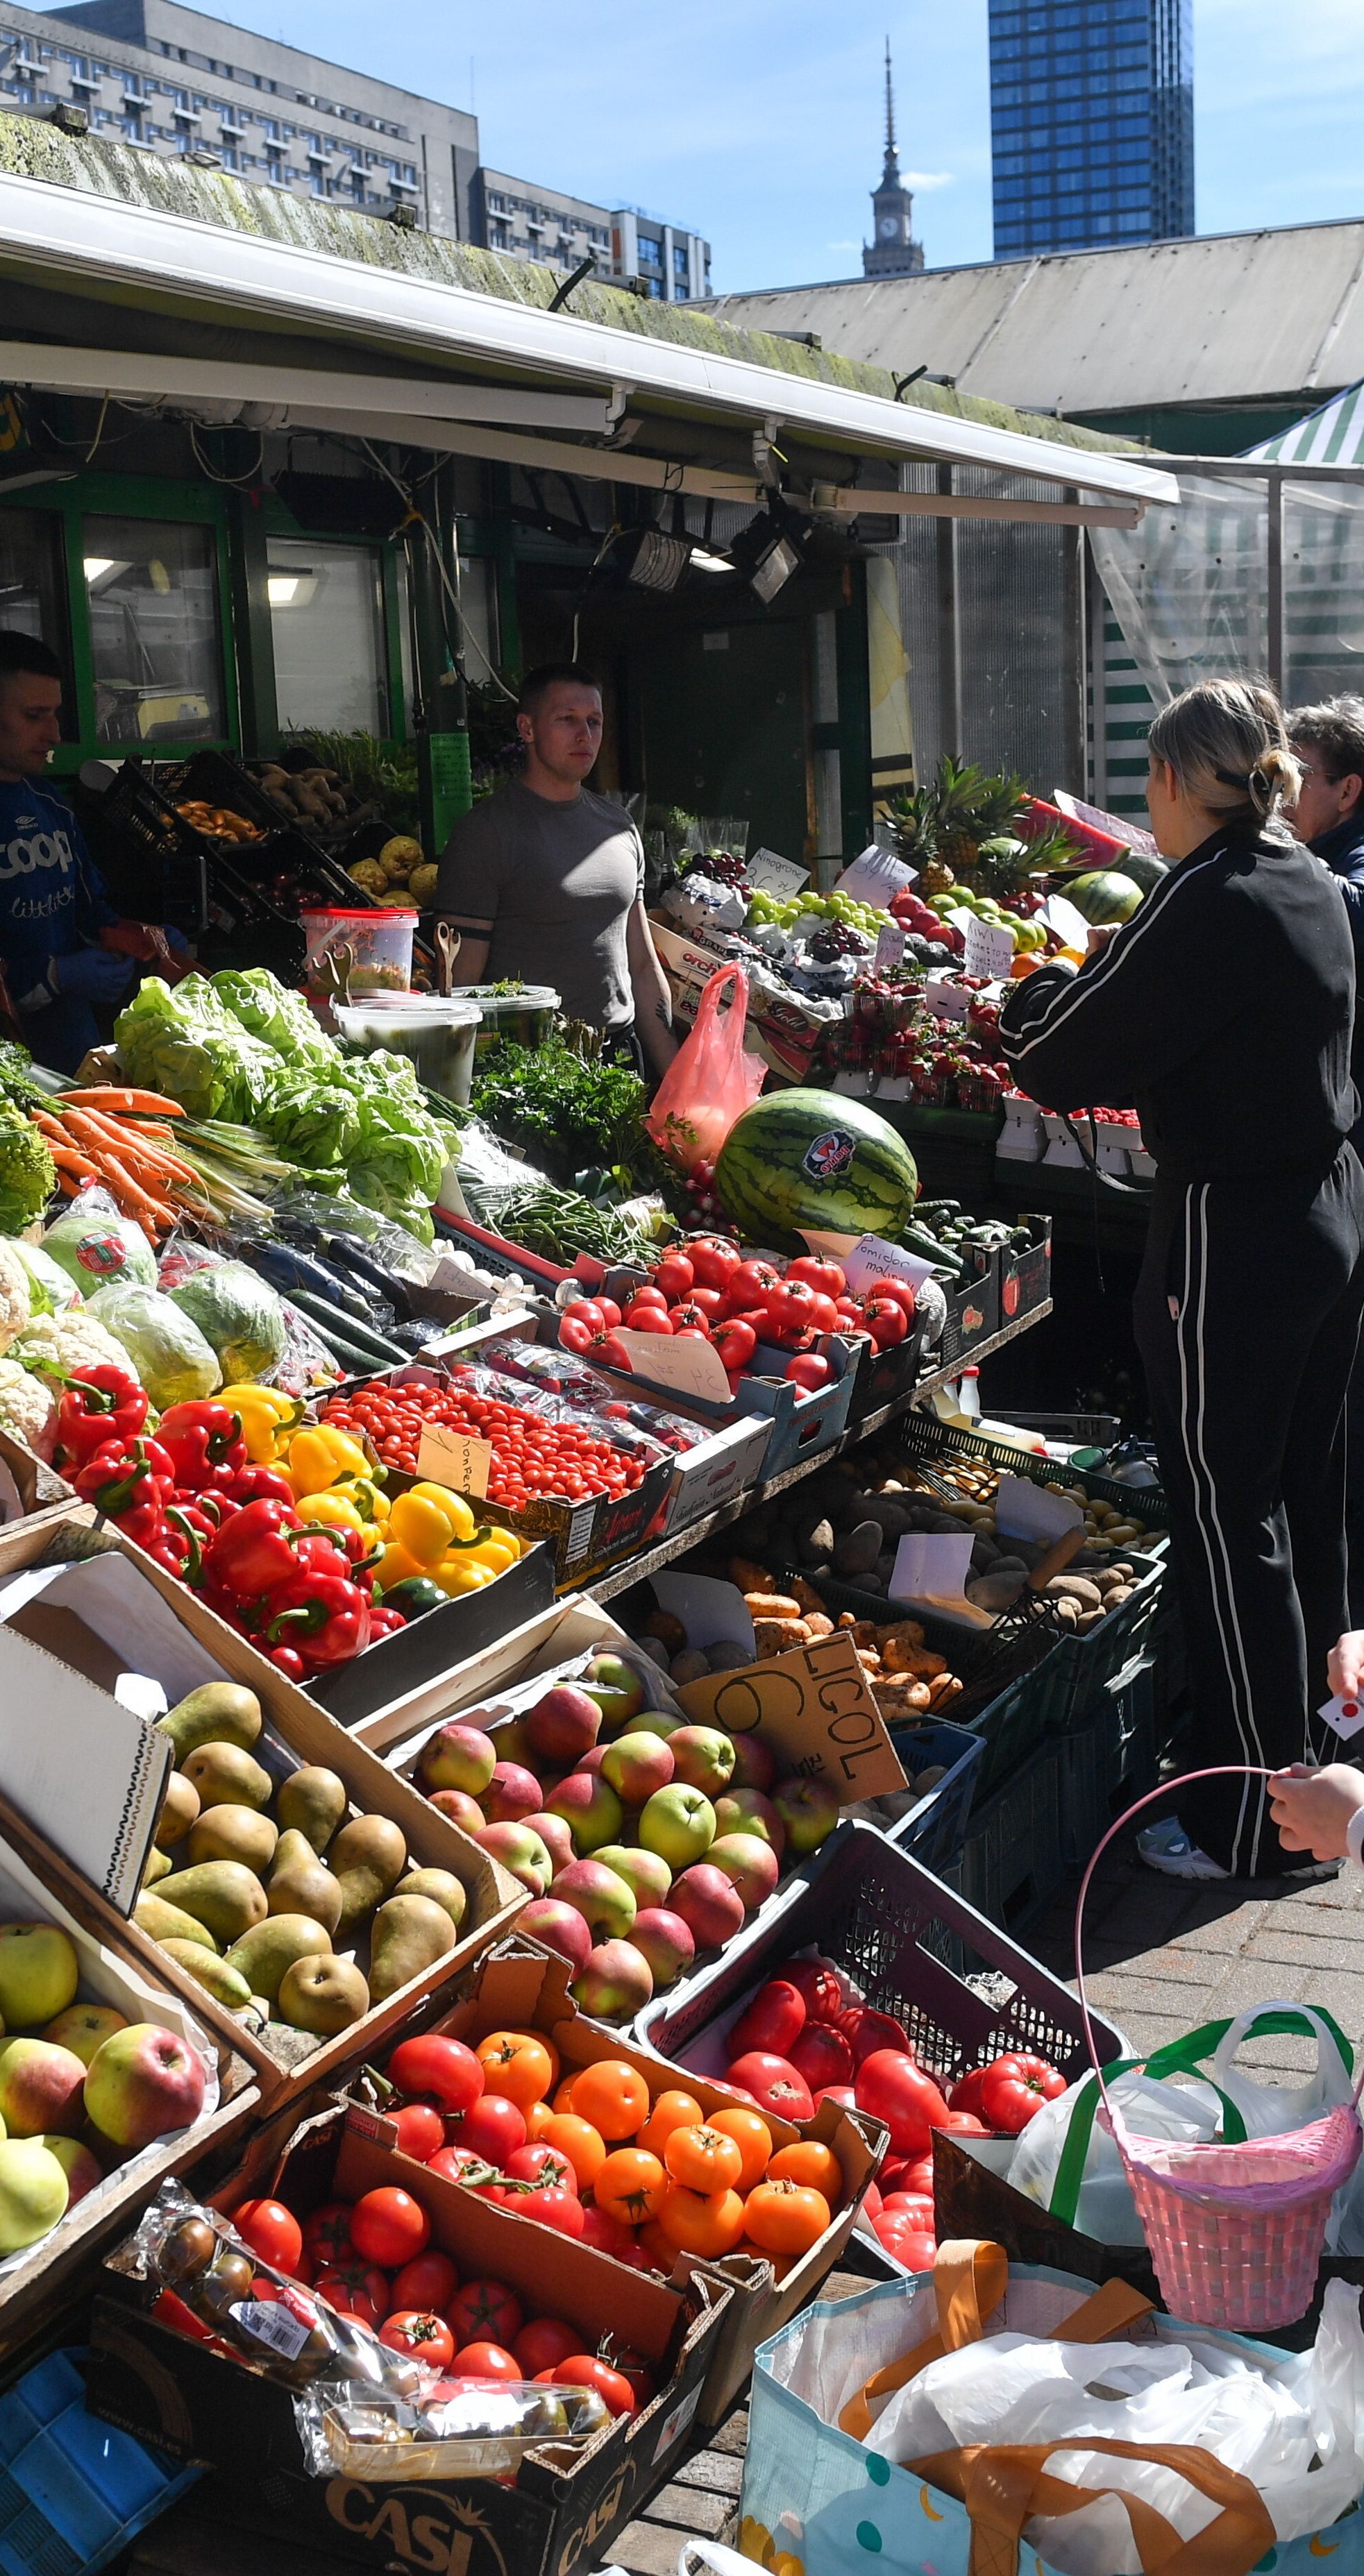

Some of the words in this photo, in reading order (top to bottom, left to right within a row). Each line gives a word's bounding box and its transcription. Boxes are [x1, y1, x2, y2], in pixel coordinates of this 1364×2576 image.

[774, 1003, 805, 1028] Gold
[855, 1235, 910, 1268] Pomidor
[714, 1670, 805, 1733] 6
[802, 1638, 883, 1781] LIGOL
[326, 2477, 473, 2576] CASI
[558, 2477, 625, 2576] CASI
